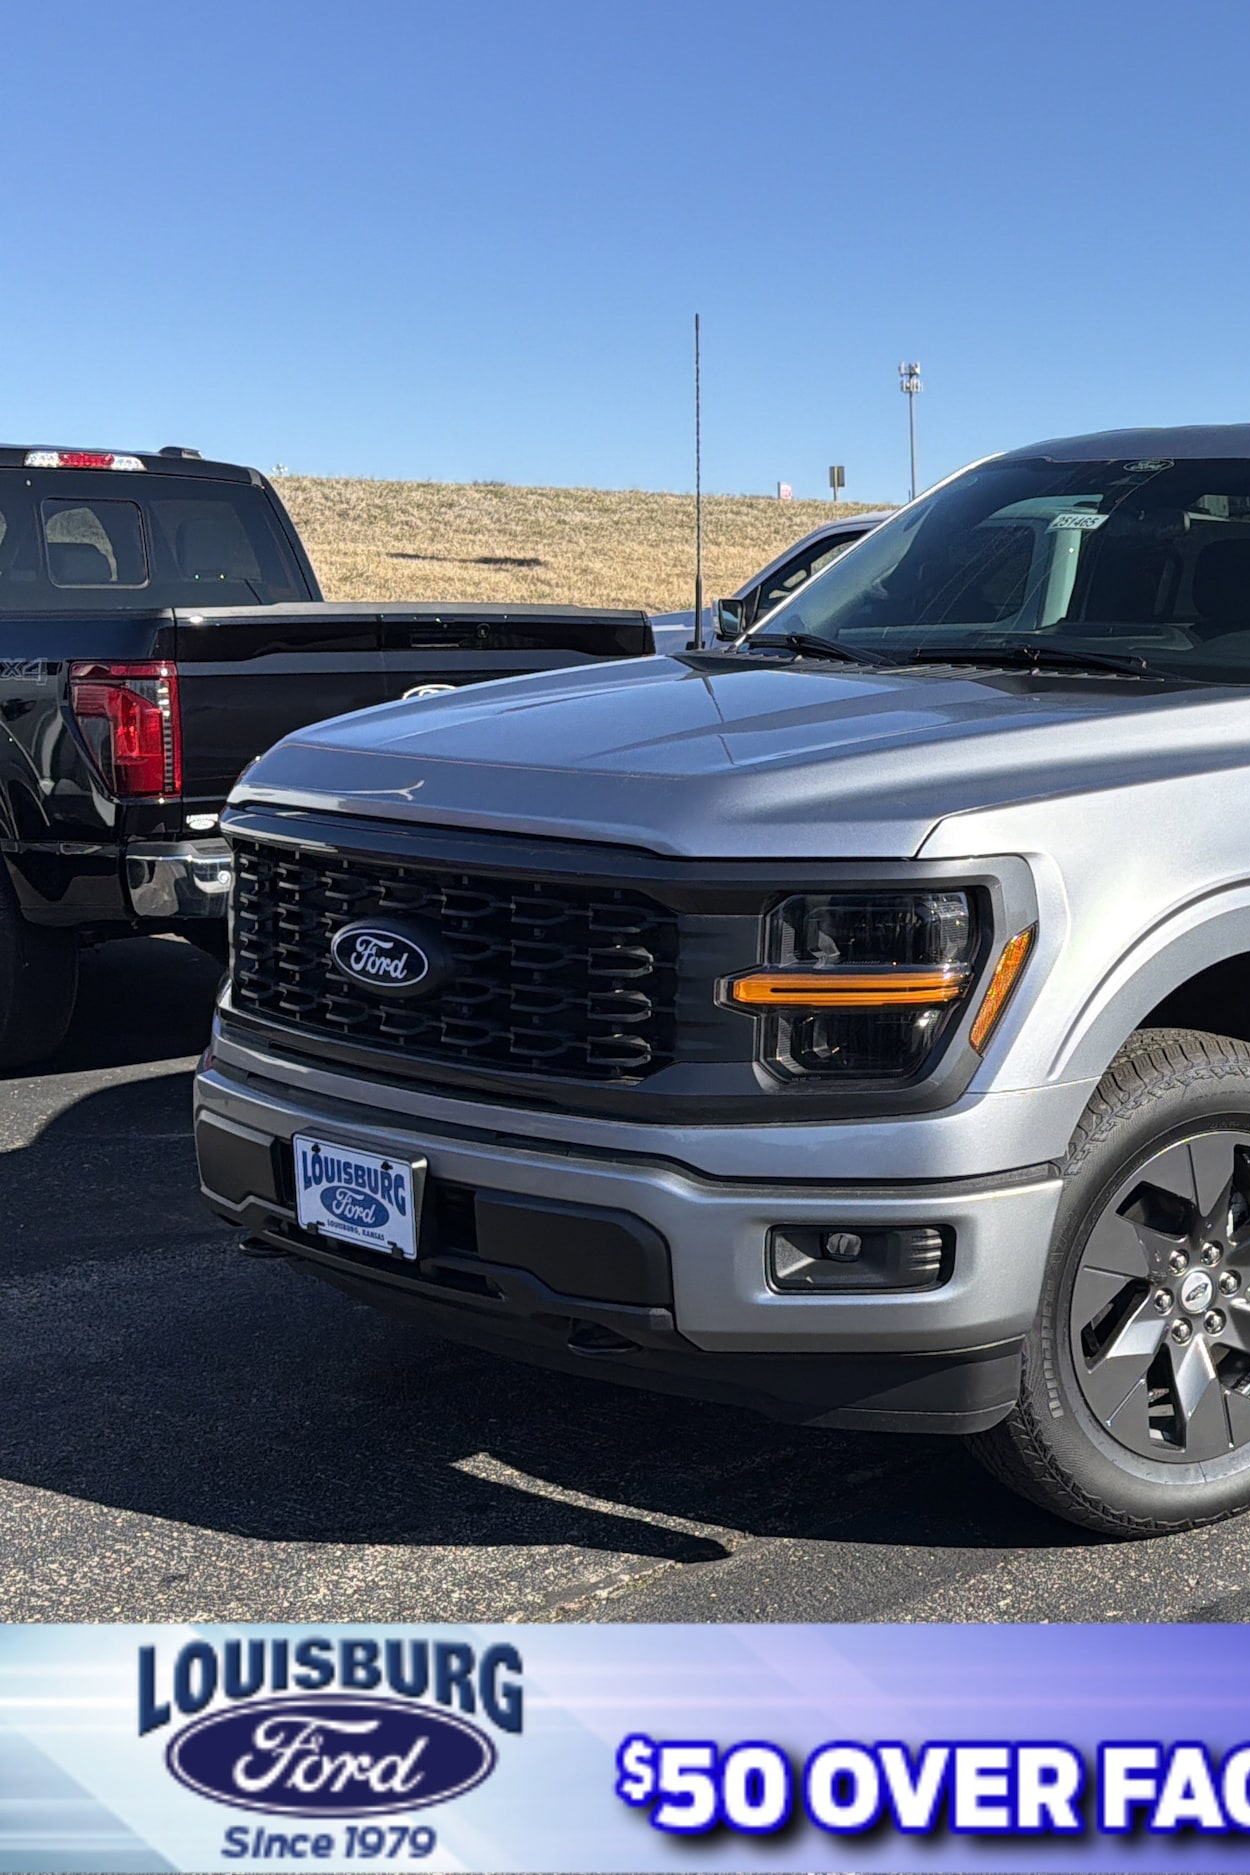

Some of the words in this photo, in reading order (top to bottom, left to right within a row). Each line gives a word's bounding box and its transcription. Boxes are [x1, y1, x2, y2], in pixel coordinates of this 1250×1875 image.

[350, 935, 409, 979] Ford
[302, 1150, 407, 1217] LOUISBURG
[332, 1187, 377, 1224] Ford
